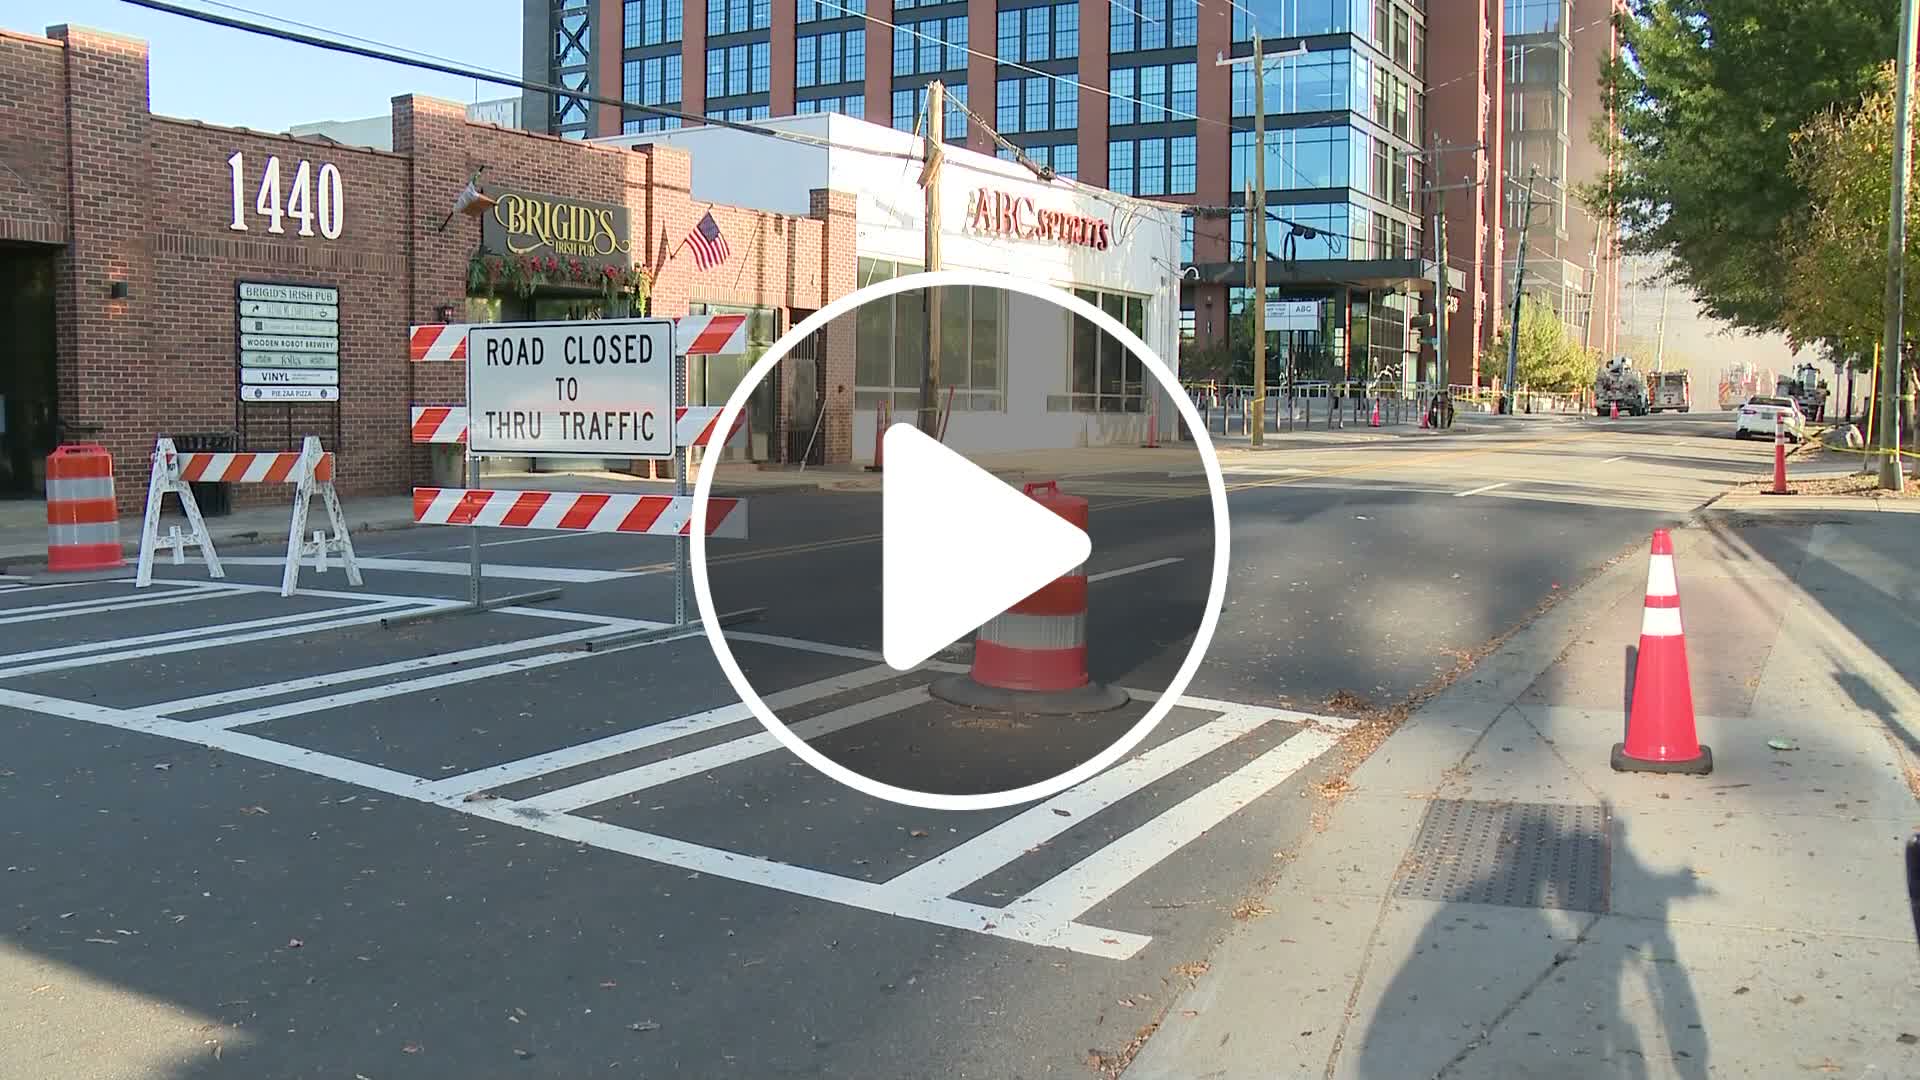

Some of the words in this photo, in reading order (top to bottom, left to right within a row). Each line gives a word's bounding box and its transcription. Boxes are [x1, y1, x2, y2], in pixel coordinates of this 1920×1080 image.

[228, 150, 344, 240] 1440
[494, 193, 631, 255] BRIGID'S
[970, 187, 1035, 240] ABC
[1036, 207, 1109, 251] SPIRITS
[555, 241, 578, 255] IRISH
[578, 243, 596, 257] PUB
[246, 287, 287, 299] BRIGID'S
[289, 289, 313, 300] IRISH
[315, 291, 333, 302] PUB
[247, 339, 279, 348] WOODEN
[281, 340, 303, 348] ROBOT
[305, 341, 334, 350] BREWERY
[486, 336, 545, 366] ROAD
[564, 334, 653, 365] CLOSED
[261, 372, 290, 382] VINYL
[555, 377, 578, 401] TO
[485, 411, 541, 439] THRU
[559, 411, 655, 440] TRAFFIC
